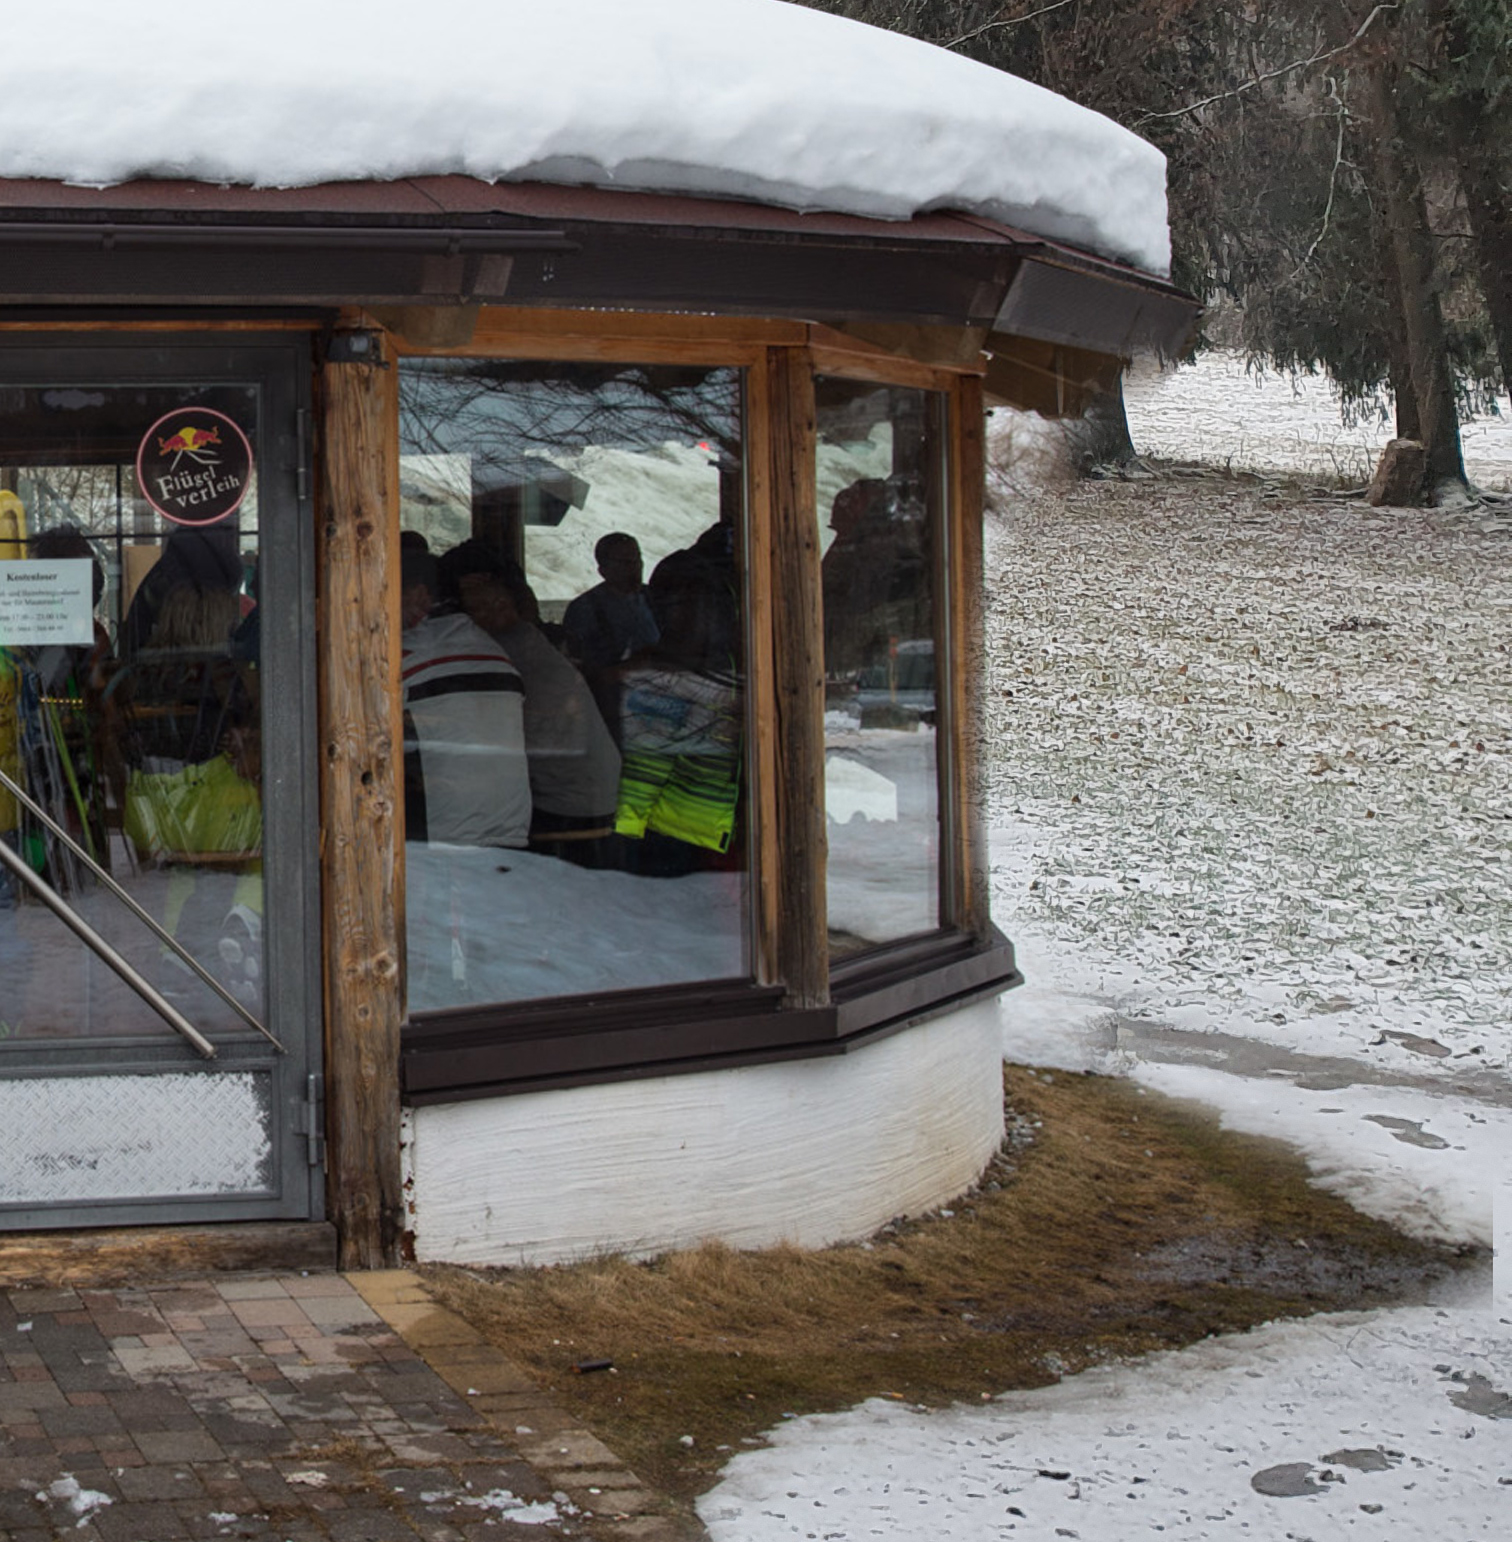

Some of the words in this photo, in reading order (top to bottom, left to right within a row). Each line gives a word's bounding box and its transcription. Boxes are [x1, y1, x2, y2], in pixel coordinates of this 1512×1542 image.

[157, 464, 216, 501] Flügel
[176, 475, 240, 508] verleih
[6, 572, 58, 582] Kostenloser
